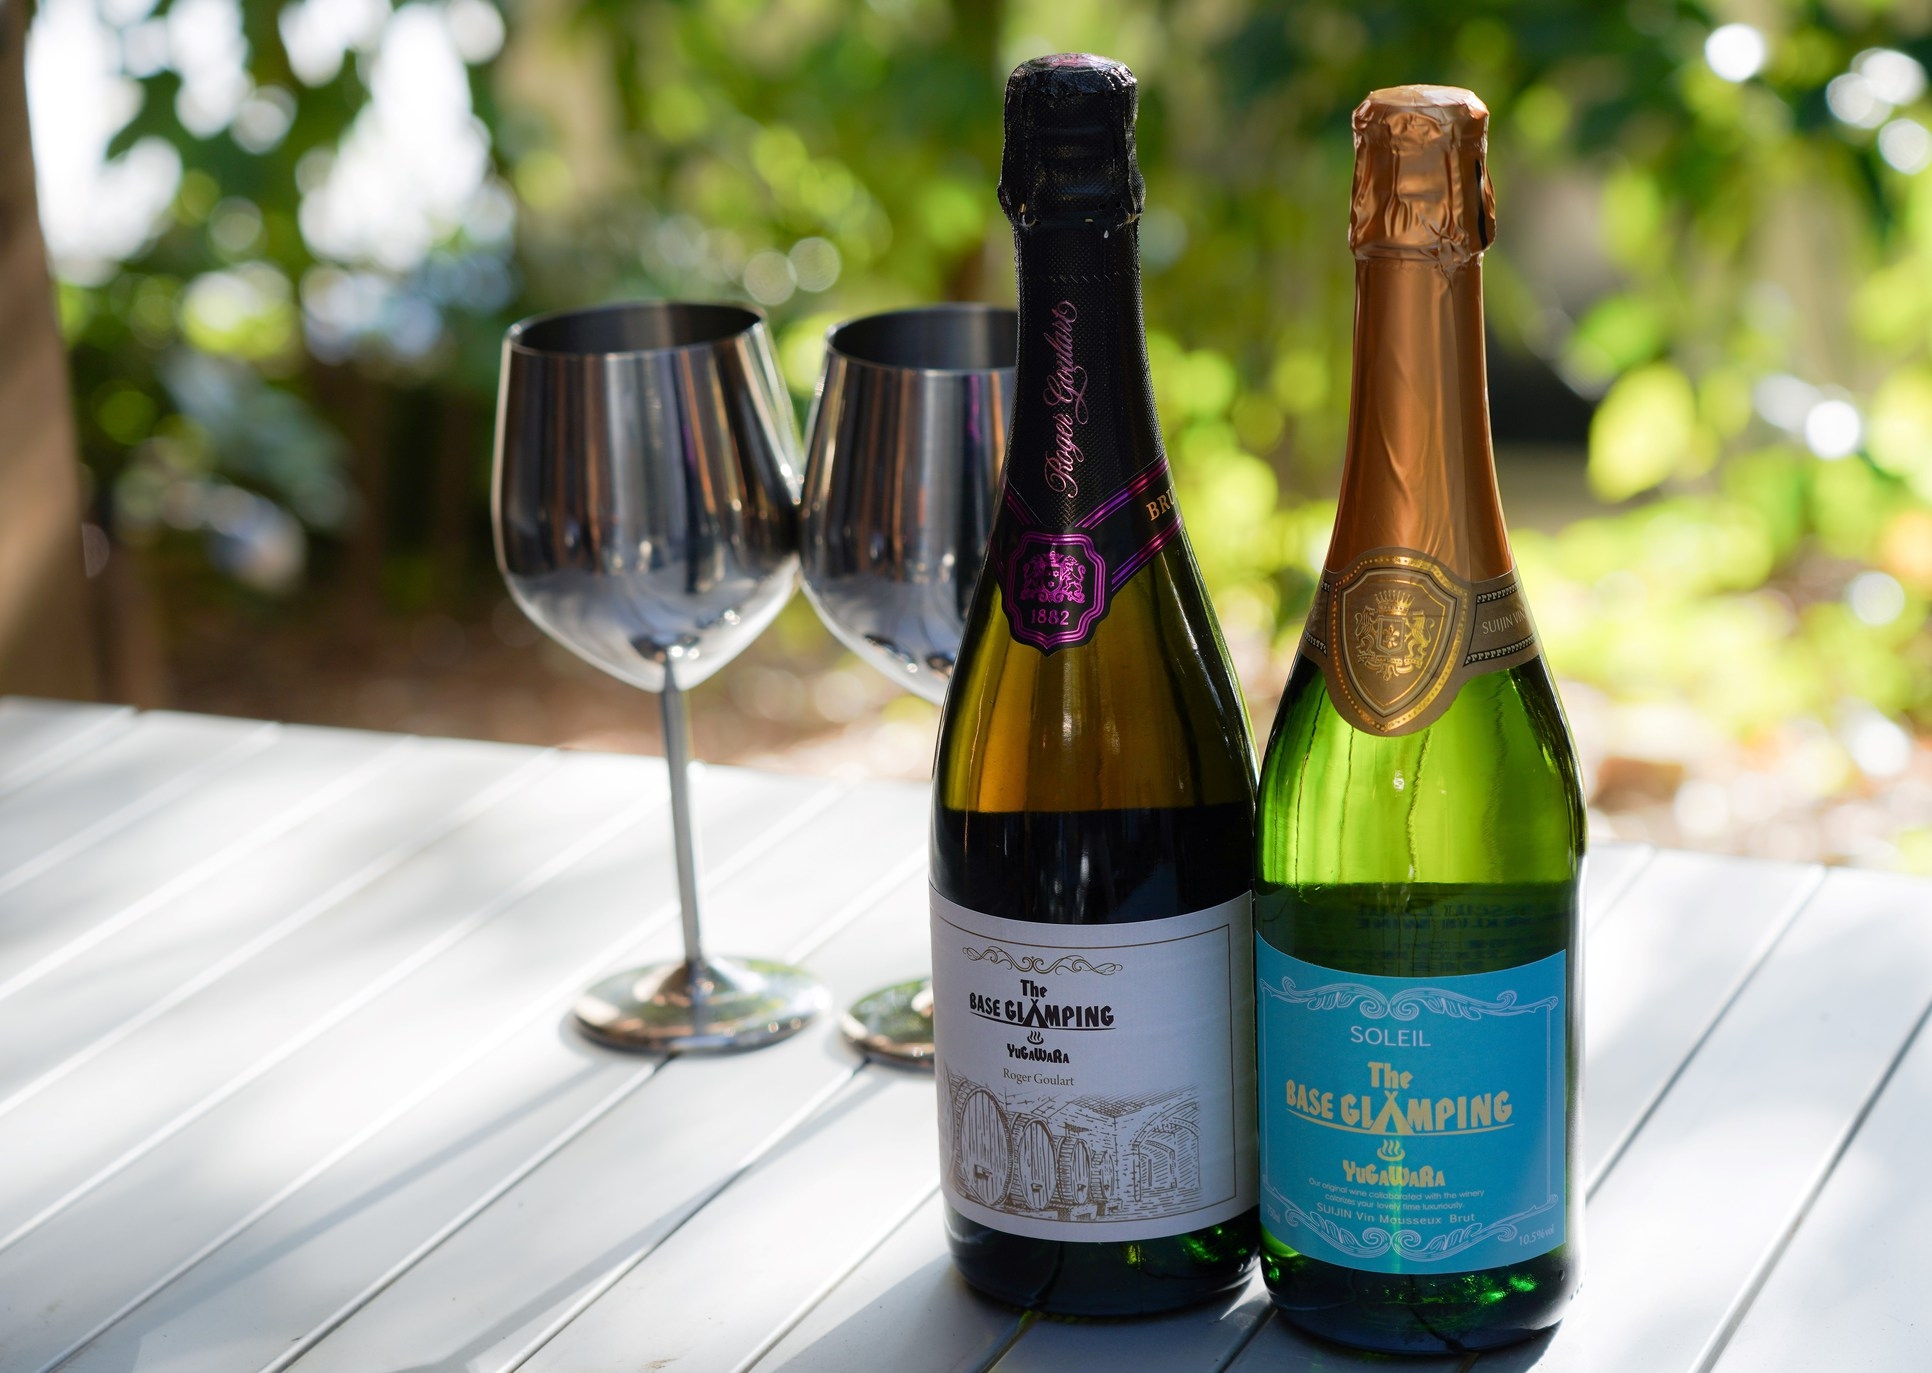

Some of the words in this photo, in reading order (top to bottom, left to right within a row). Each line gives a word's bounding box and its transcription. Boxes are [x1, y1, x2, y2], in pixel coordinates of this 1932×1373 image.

[1043, 299, 1089, 425] Goulart
[1044, 413, 1085, 499] Roger
[1030, 607, 1070, 627] 1882
[1481, 614, 1514, 635] SUIJIN
[1020, 978, 1048, 998] The
[969, 992, 1001, 1017] BASE
[1004, 998, 1115, 1028] GLAMPING
[1350, 1025, 1432, 1047] SOLEIL
[1003, 1067, 1032, 1085] Roger
[1033, 1073, 1075, 1087] Goulart
[1367, 1061, 1414, 1090] The
[1285, 1078, 1334, 1120] BASE
[1340, 1089, 1513, 1135] GLAMPING
[1308, 1177, 1321, 1187] Our
[1321, 1182, 1348, 1194] original
[1349, 1187, 1367, 1197] wine
[1368, 1191, 1423, 1201] collaborated
[1424, 1192, 1442, 1201] with
[1443, 1191, 1457, 1199] the
[1459, 1189, 1485, 1199] winery
[1316, 1202, 1352, 1219] SUIJIN
[1356, 1211, 1375, 1222] Vin
[1379, 1214, 1442, 1225] Mousseux
[1449, 1213, 1475, 1224] Brut
[1325, 1193, 1356, 1206] colorizes
[1357, 1199, 1374, 1209] your
[1376, 1201, 1401, 1211] lovely
[1402, 1202, 1421, 1211] time
